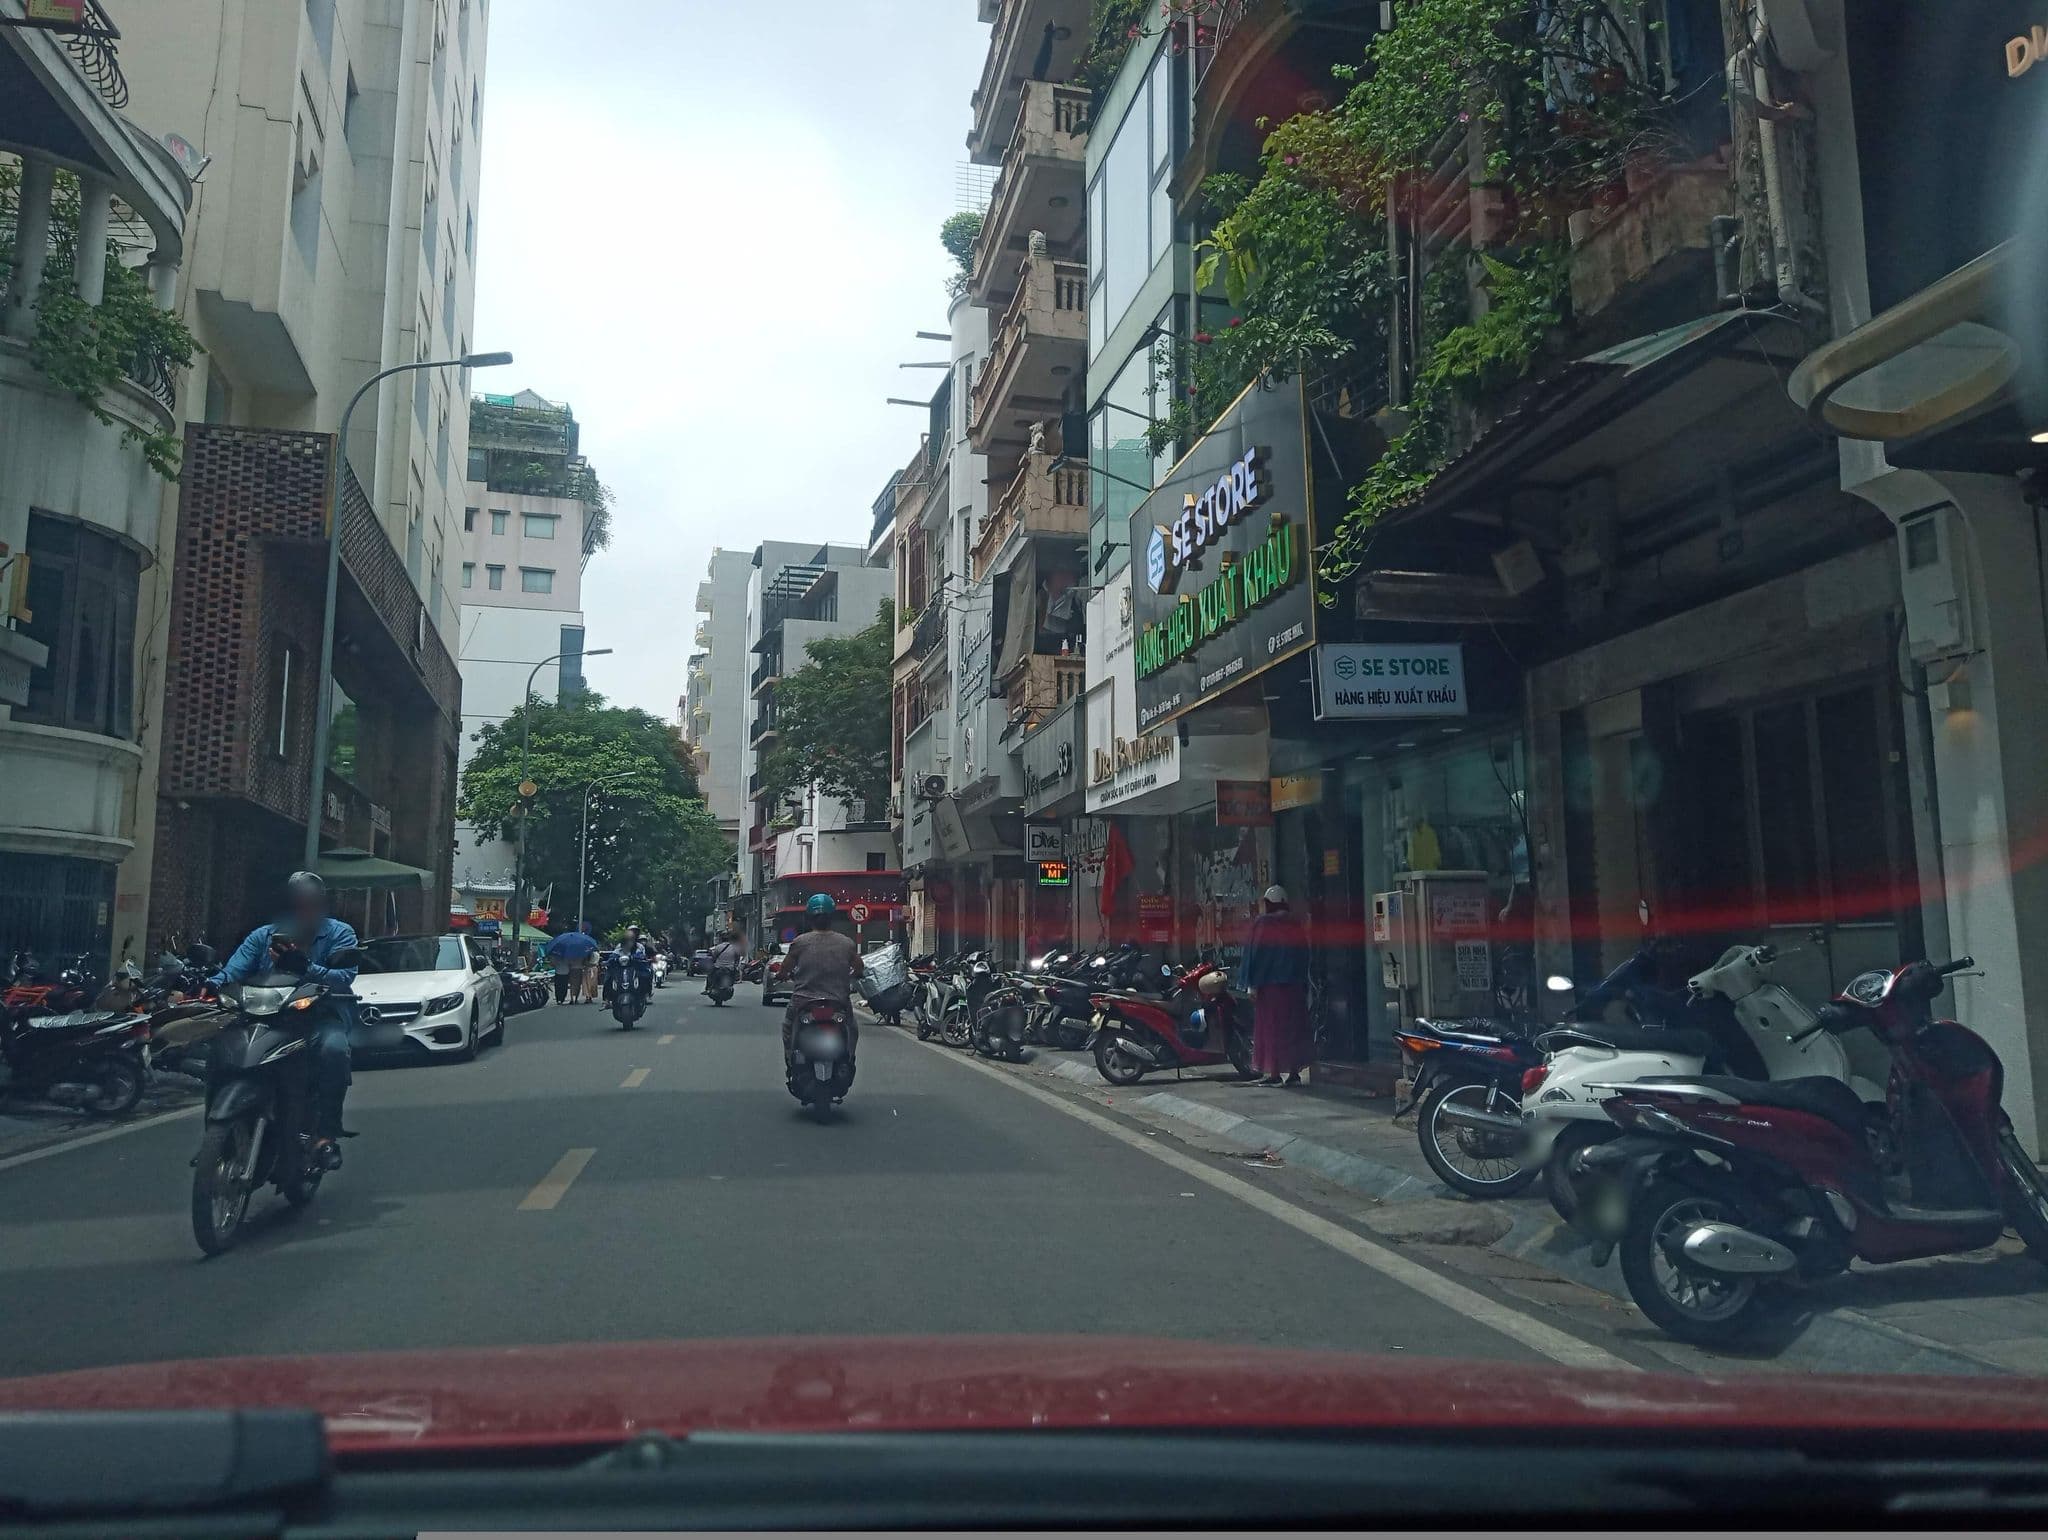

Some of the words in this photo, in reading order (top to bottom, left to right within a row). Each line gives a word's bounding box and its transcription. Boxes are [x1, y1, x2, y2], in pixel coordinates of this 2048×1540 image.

[2005, 25, 2048, 78] DI
[1194, 447, 1258, 547] STORE
[1361, 658, 1385, 676] SE
[1388, 658, 1450, 677] STORE
[1335, 688, 1364, 706] HÀNG
[1367, 688, 1391, 707] HIỆU
[1394, 685, 1424, 705] XUẤT
[1427, 684, 1457, 704] KHẨU
